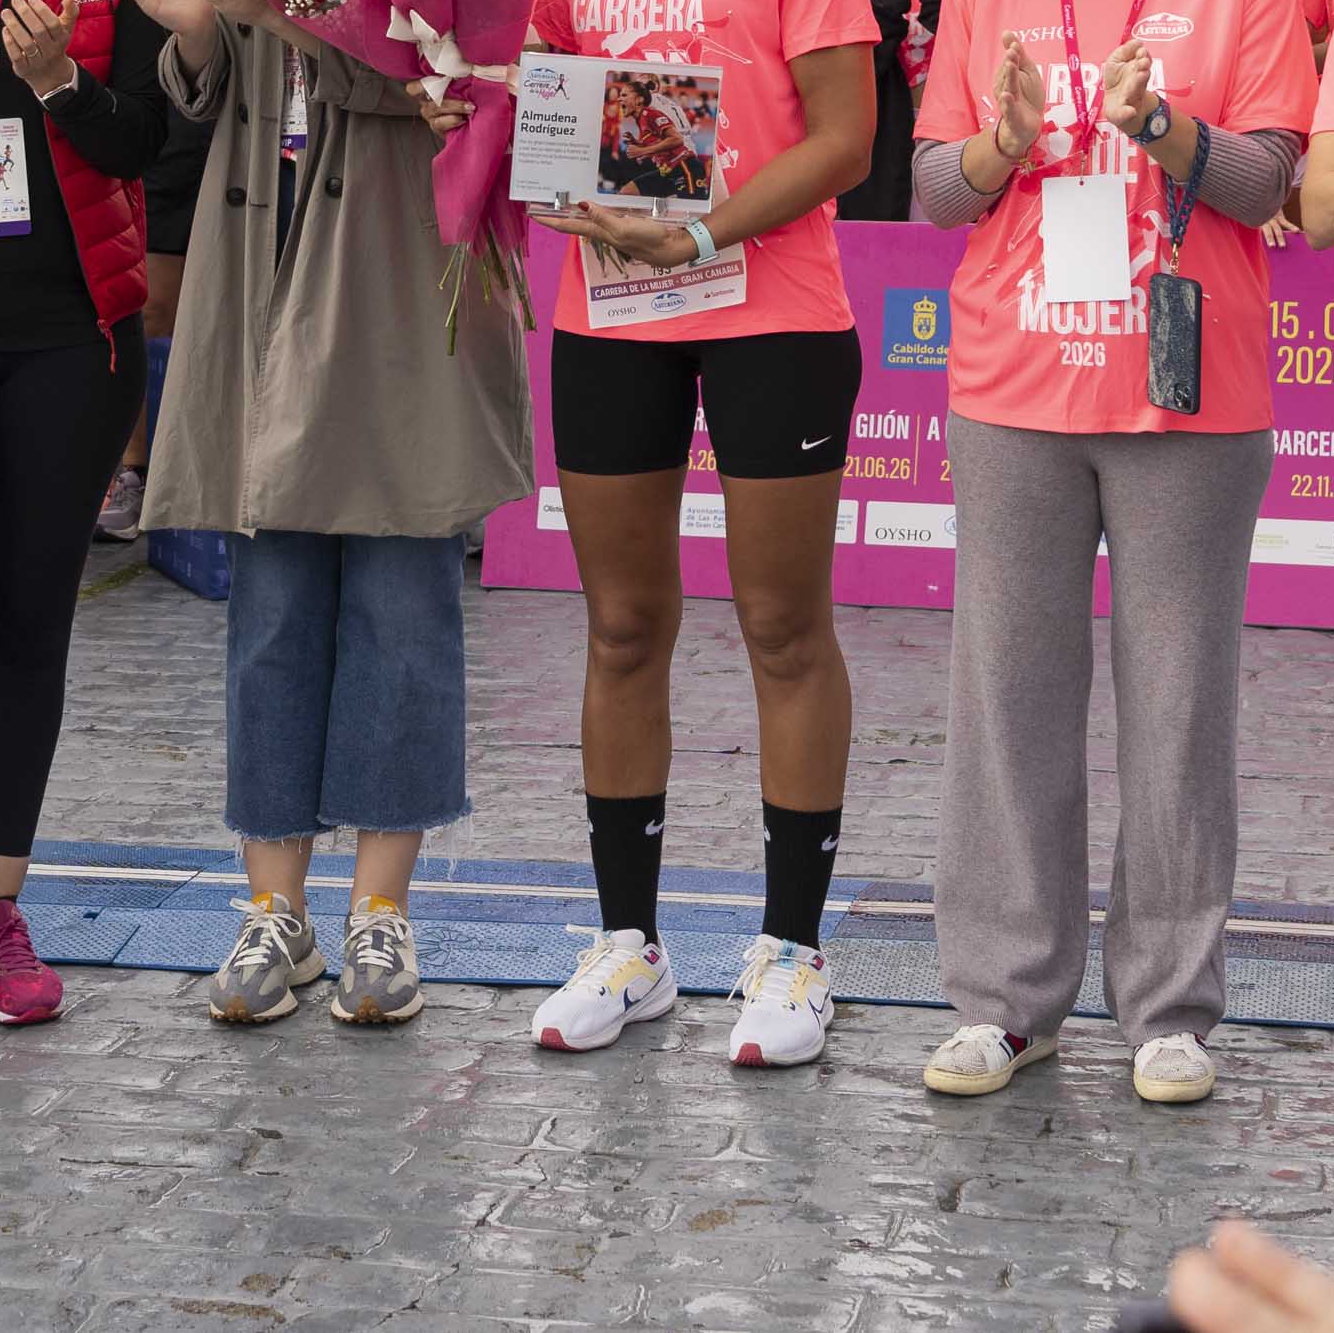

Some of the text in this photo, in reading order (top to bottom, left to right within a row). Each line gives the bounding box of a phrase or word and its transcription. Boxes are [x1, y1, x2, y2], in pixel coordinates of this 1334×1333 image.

[521, 110, 578, 124] Almudena
[520, 122, 576, 137] Rodríguez
[594, 265, 740, 298] CARRERA DE LA MUJER GRAN CANARIA
[607, 306, 637, 318] OYSHO
[1019, 284, 1148, 337] MUJER
[893, 343, 934, 354] Cabildo
[1059, 341, 1107, 368] 2026
[887, 353, 947, 365] Gran Canar
[855, 410, 910, 440] GIJÓN
[843, 456, 910, 479] 21.06.26
[686, 506, 726, 516] Ayuntamie
[875, 527, 931, 542] OYSHO
